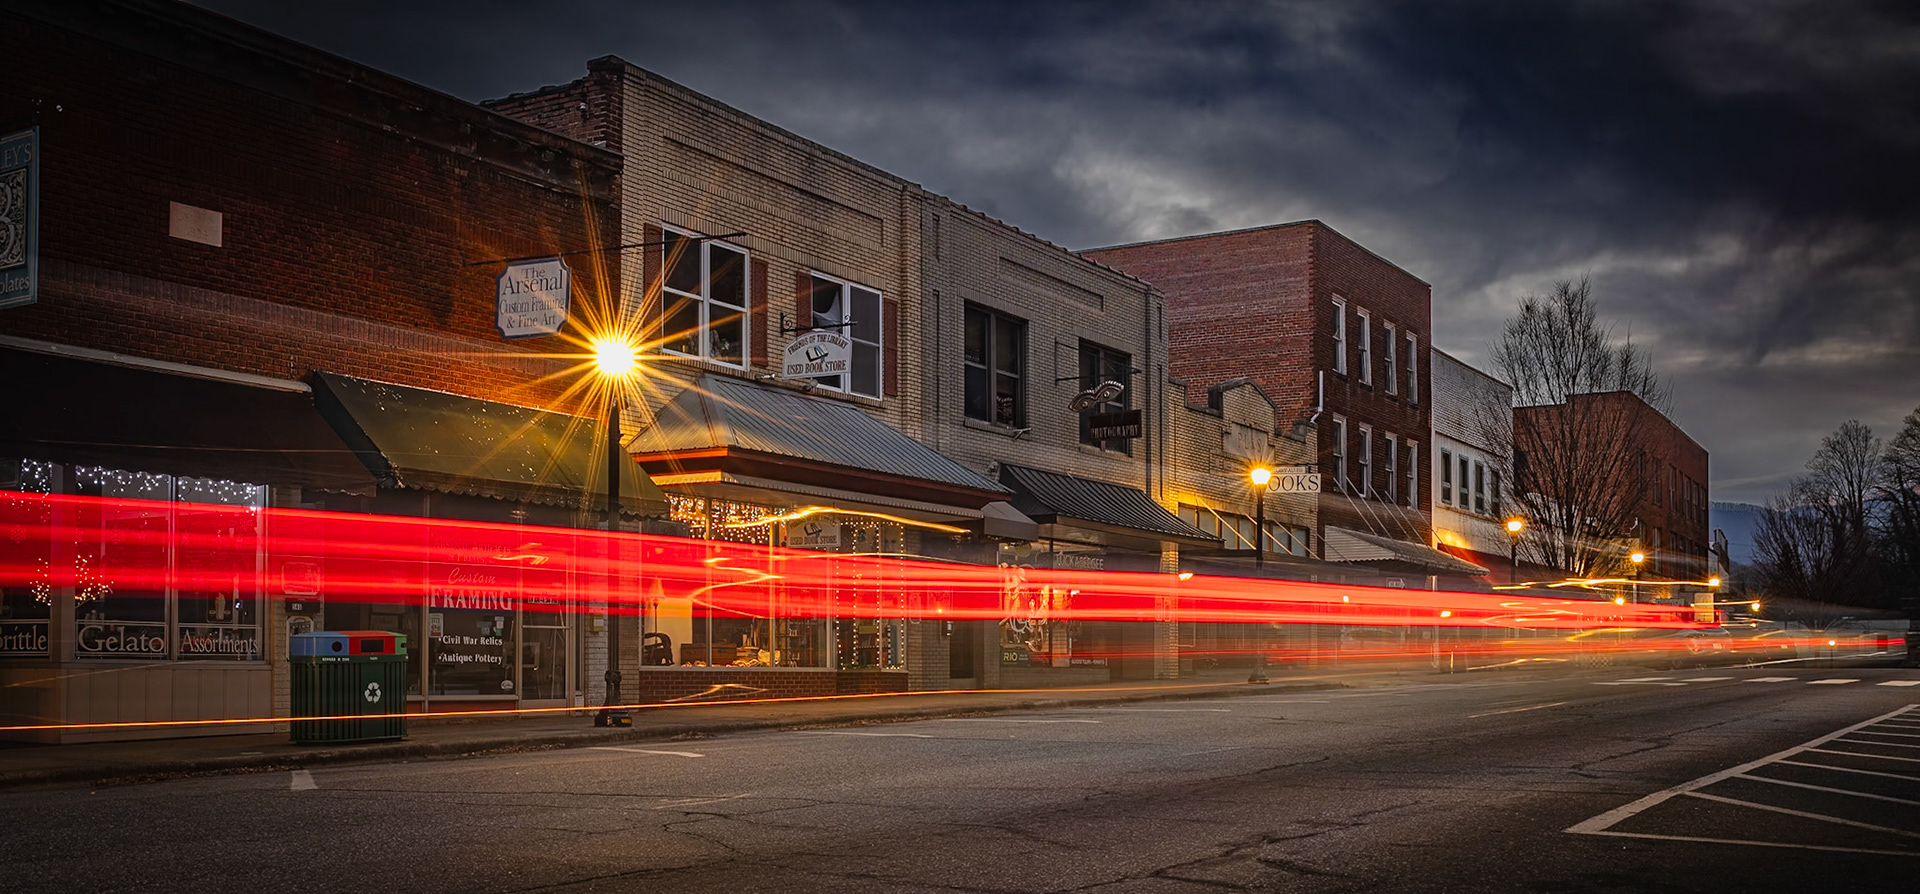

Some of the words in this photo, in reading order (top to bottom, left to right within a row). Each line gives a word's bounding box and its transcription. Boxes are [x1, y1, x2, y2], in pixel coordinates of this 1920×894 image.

[0, 143, 32, 169] EY'S
[502, 269, 563, 296] Arsenal
[522, 267, 545, 279] The
[500, 299, 530, 315] Custom
[531, 294, 565, 314] Framing
[506, 316, 515, 329] &
[518, 314, 538, 327] Fine
[541, 312, 556, 326] Art
[787, 338, 809, 355] FRIENDS
[809, 335, 816, 344] OF
[817, 334, 827, 343] THE
[827, 334, 849, 350] LIBRARY
[787, 363, 804, 375] USED
[805, 362, 823, 374] BOOK
[825, 360, 847, 372] STORE
[1268, 474, 1319, 492] OOKS
[448, 567, 497, 585] Custom
[430, 586, 513, 611] FRAMING
[0, 624, 47, 650] rittle
[78, 624, 165, 653] Gelato
[181, 626, 260, 655] Assortments
[442, 635, 461, 645] Civil
[463, 636, 478, 646] War
[480, 636, 503, 646] Relics
[442, 653, 473, 664] Antique
[475, 654, 503, 665] Pottery
[1003, 652, 1018, 662] RIO
